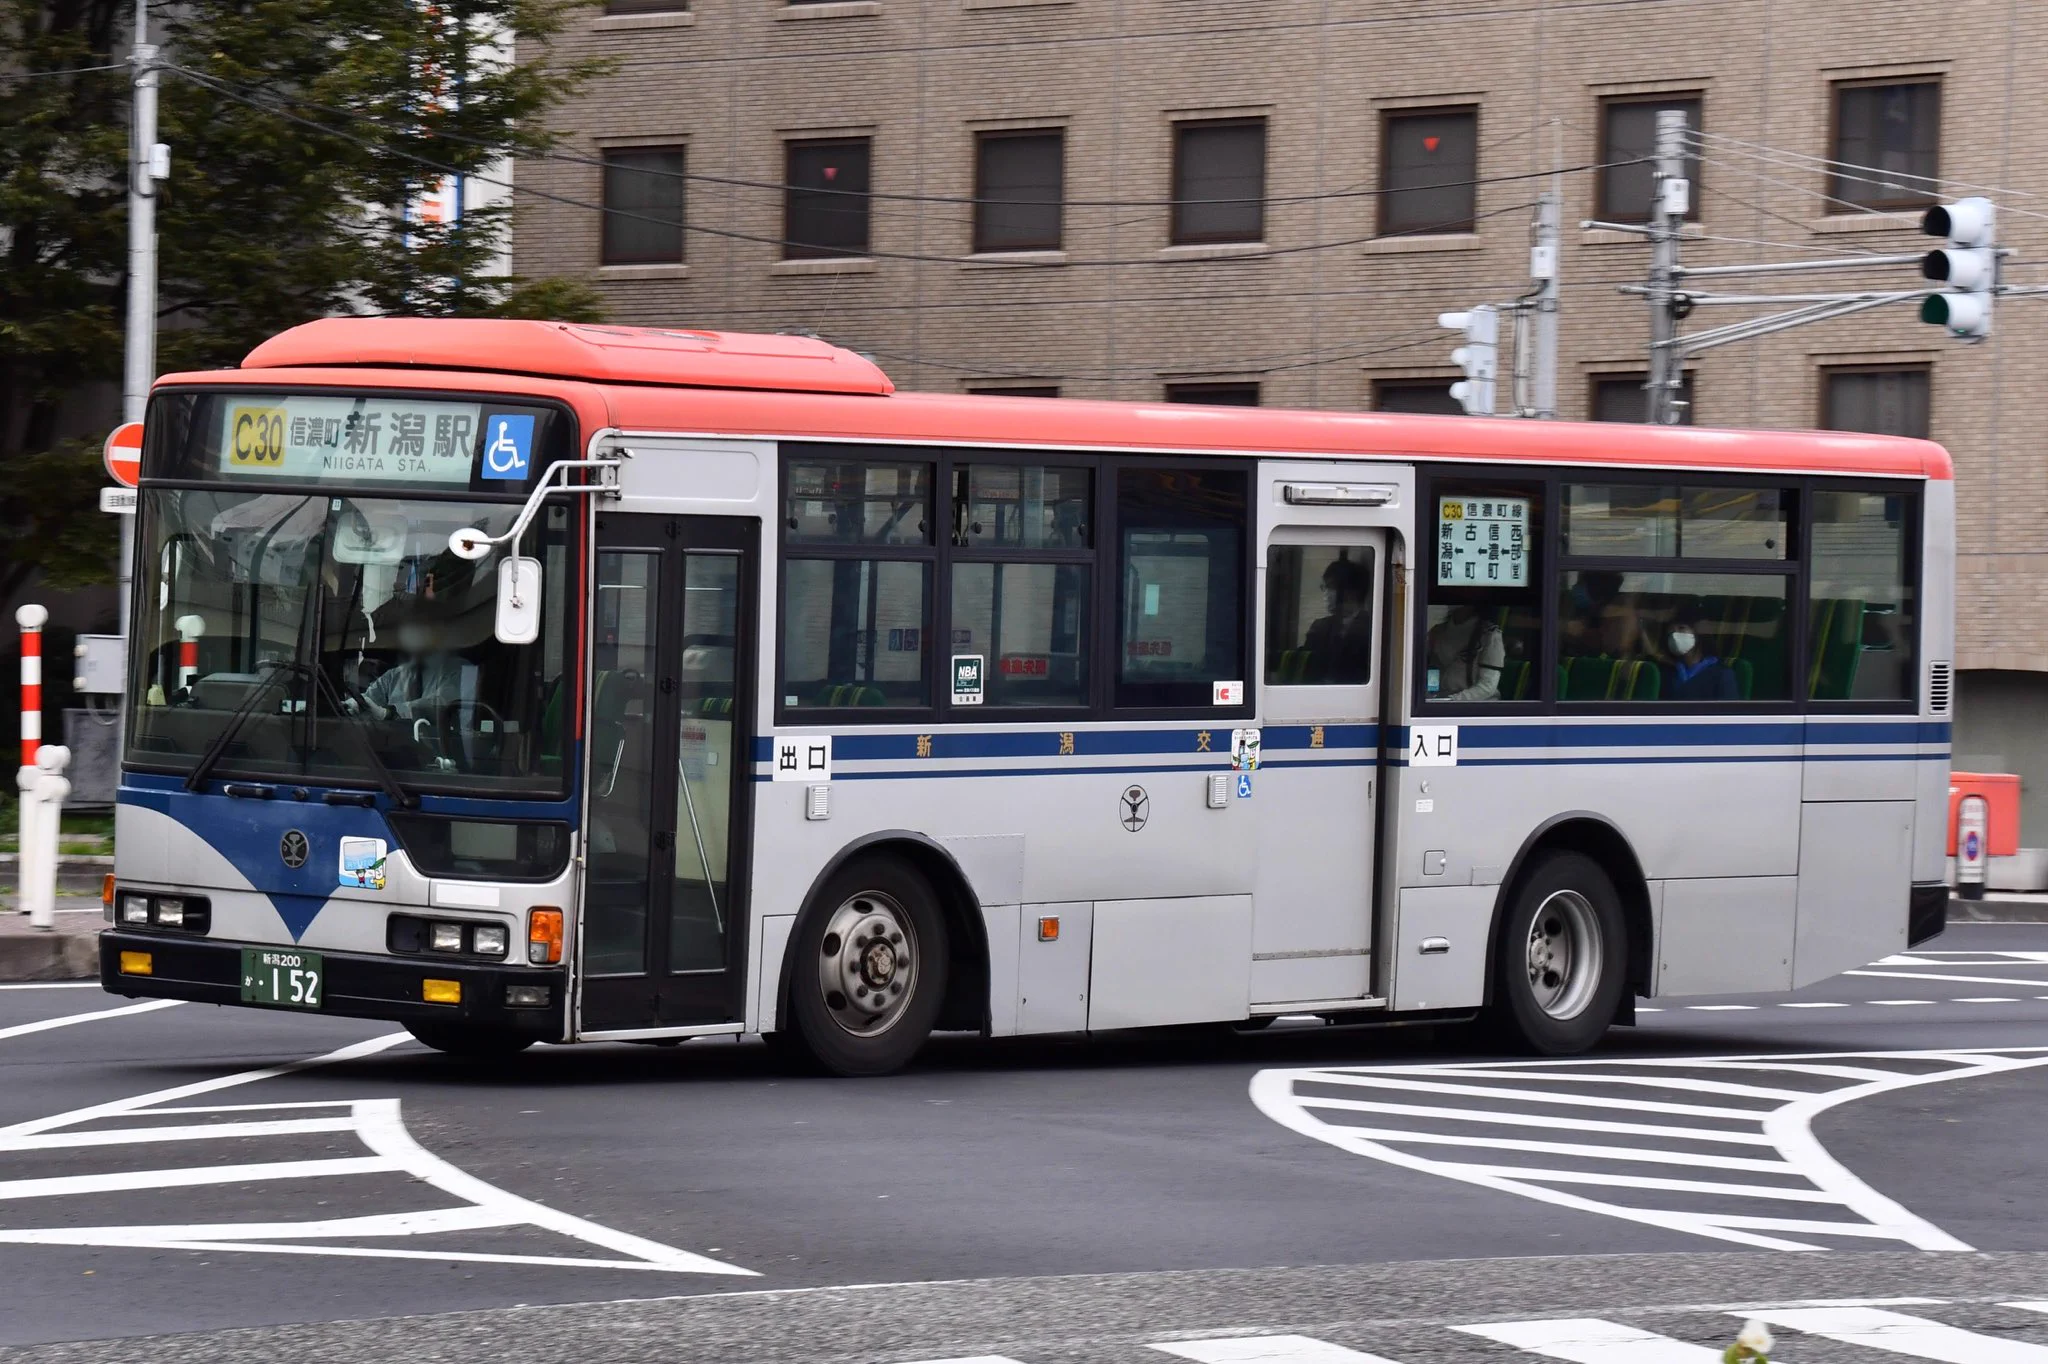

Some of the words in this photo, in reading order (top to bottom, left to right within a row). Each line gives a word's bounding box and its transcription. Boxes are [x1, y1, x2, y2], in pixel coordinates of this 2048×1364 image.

[235, 413, 283, 461] C30
[290, 416, 342, 448] 信濃町
[344, 411, 472, 458] 新潟駅
[323, 456, 384, 471] NIIGATA
[398, 458, 431, 472] STA.
[1443, 504, 1462, 518] C30
[1441, 522, 1453, 579] 新潟駅
[958, 665, 977, 677] NBA
[1414, 734, 1452, 757] 入口
[780, 745, 826, 771] 出口
